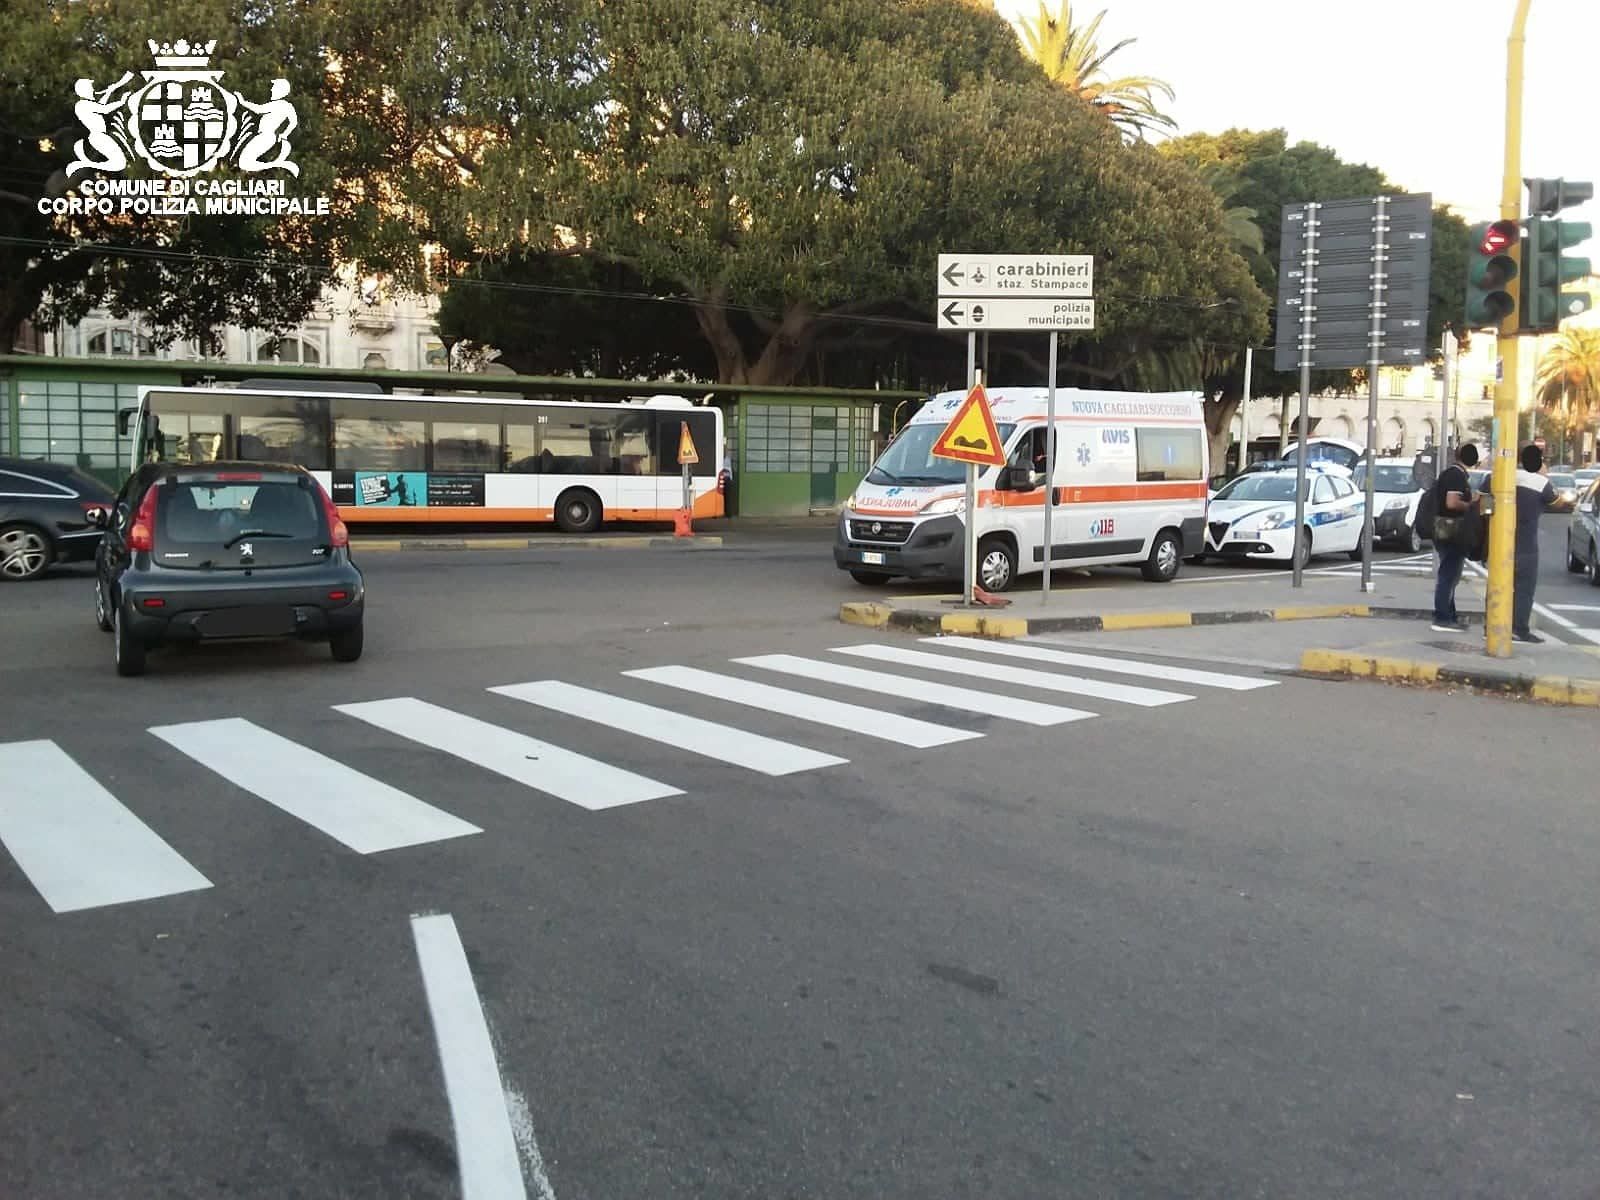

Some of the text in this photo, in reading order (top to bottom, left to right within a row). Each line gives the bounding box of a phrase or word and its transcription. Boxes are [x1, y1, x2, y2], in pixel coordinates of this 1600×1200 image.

[997, 262, 1089, 276] carabinieri
[997, 279, 1089, 290] staz. Stampace
[1053, 303, 1091, 314] polizia
[1028, 315, 1091, 326] municipale
[1072, 401, 1103, 414] NUOVA
[1104, 402, 1148, 415] CAGLIARI
[1102, 428, 1130, 444] AVIS
[1100, 519, 1114, 535] 118
